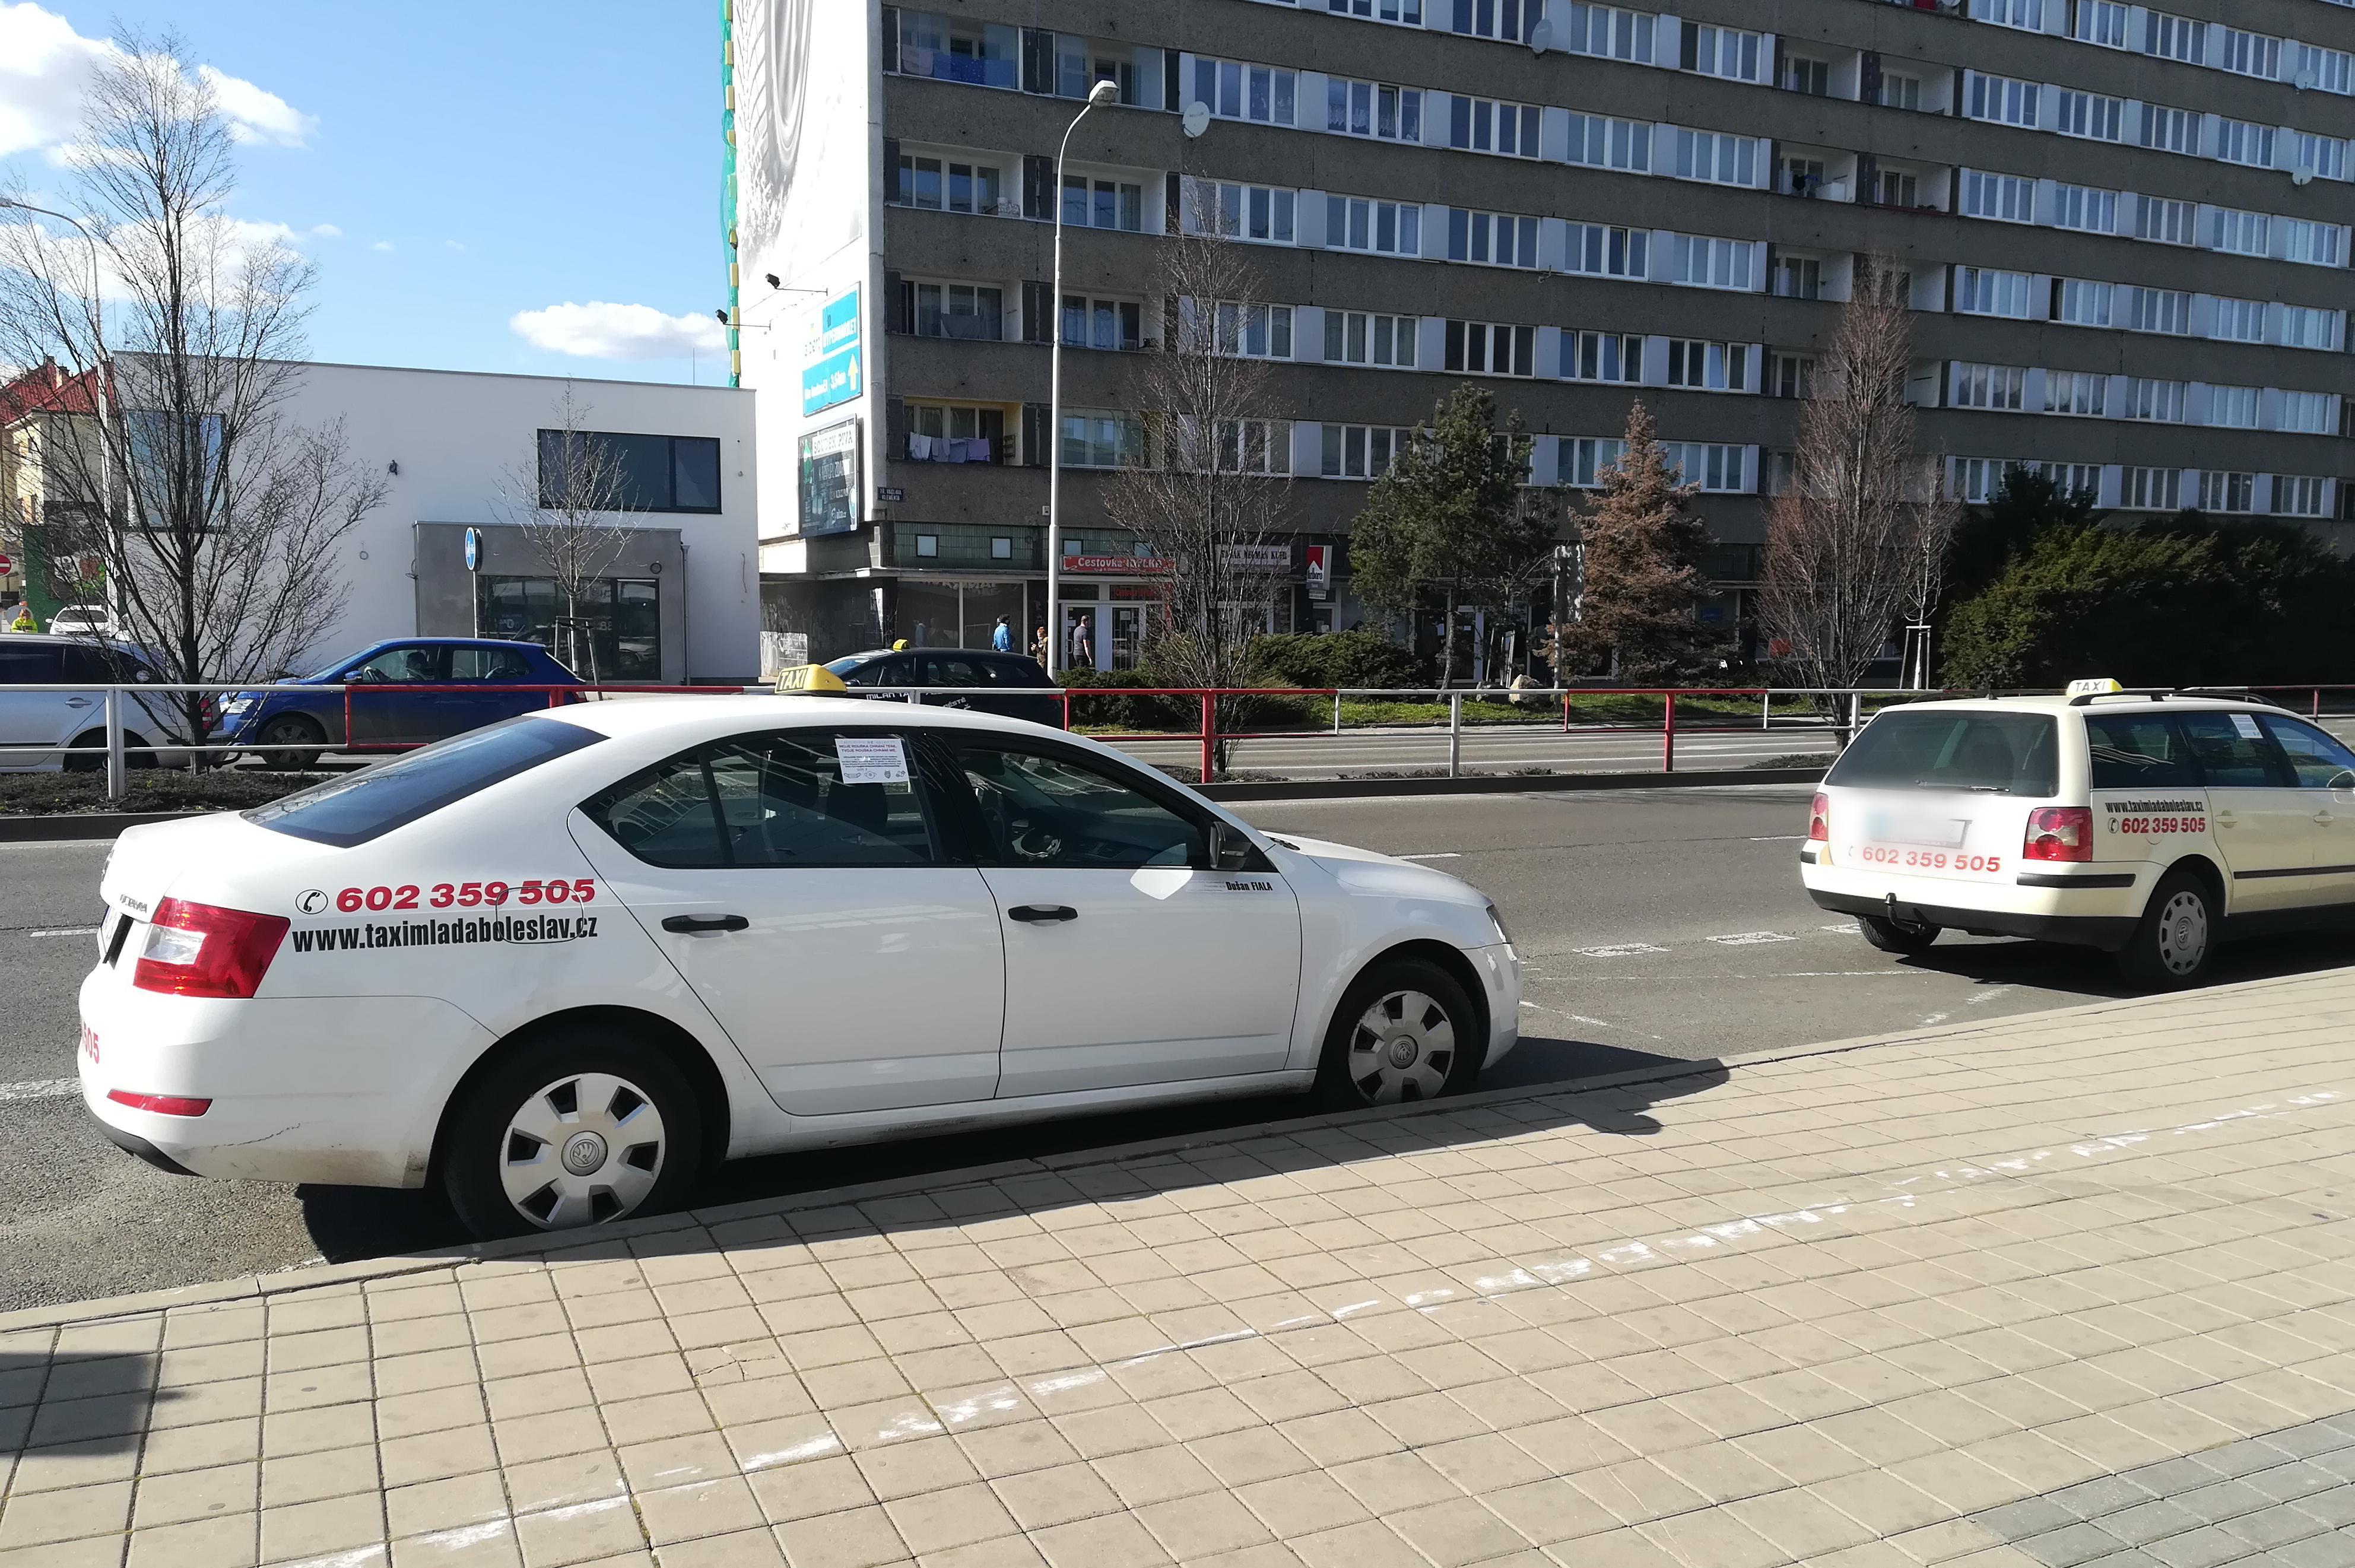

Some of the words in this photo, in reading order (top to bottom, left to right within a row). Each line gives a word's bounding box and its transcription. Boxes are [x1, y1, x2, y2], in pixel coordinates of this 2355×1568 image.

[779, 669, 808, 691] TAXI
[2076, 681, 2106, 692] TAXI
[2105, 799, 2204, 813] www.taximladaboleslav.cz
[2122, 817, 2150, 833] 602
[2152, 817, 2178, 833] 359
[2181, 817, 2206, 833] 505
[1862, 846, 1899, 865] 602
[1906, 850, 1947, 869] 359
[1954, 854, 2001, 872] 505
[336, 884, 420, 913] 602
[429, 881, 510, 908] 359
[518, 878, 595, 905] 505
[1225, 881, 1250, 891] Dušan
[1251, 881, 1273, 891] FIALA
[291, 914, 598, 953] www.taximladaboleslav.cz
